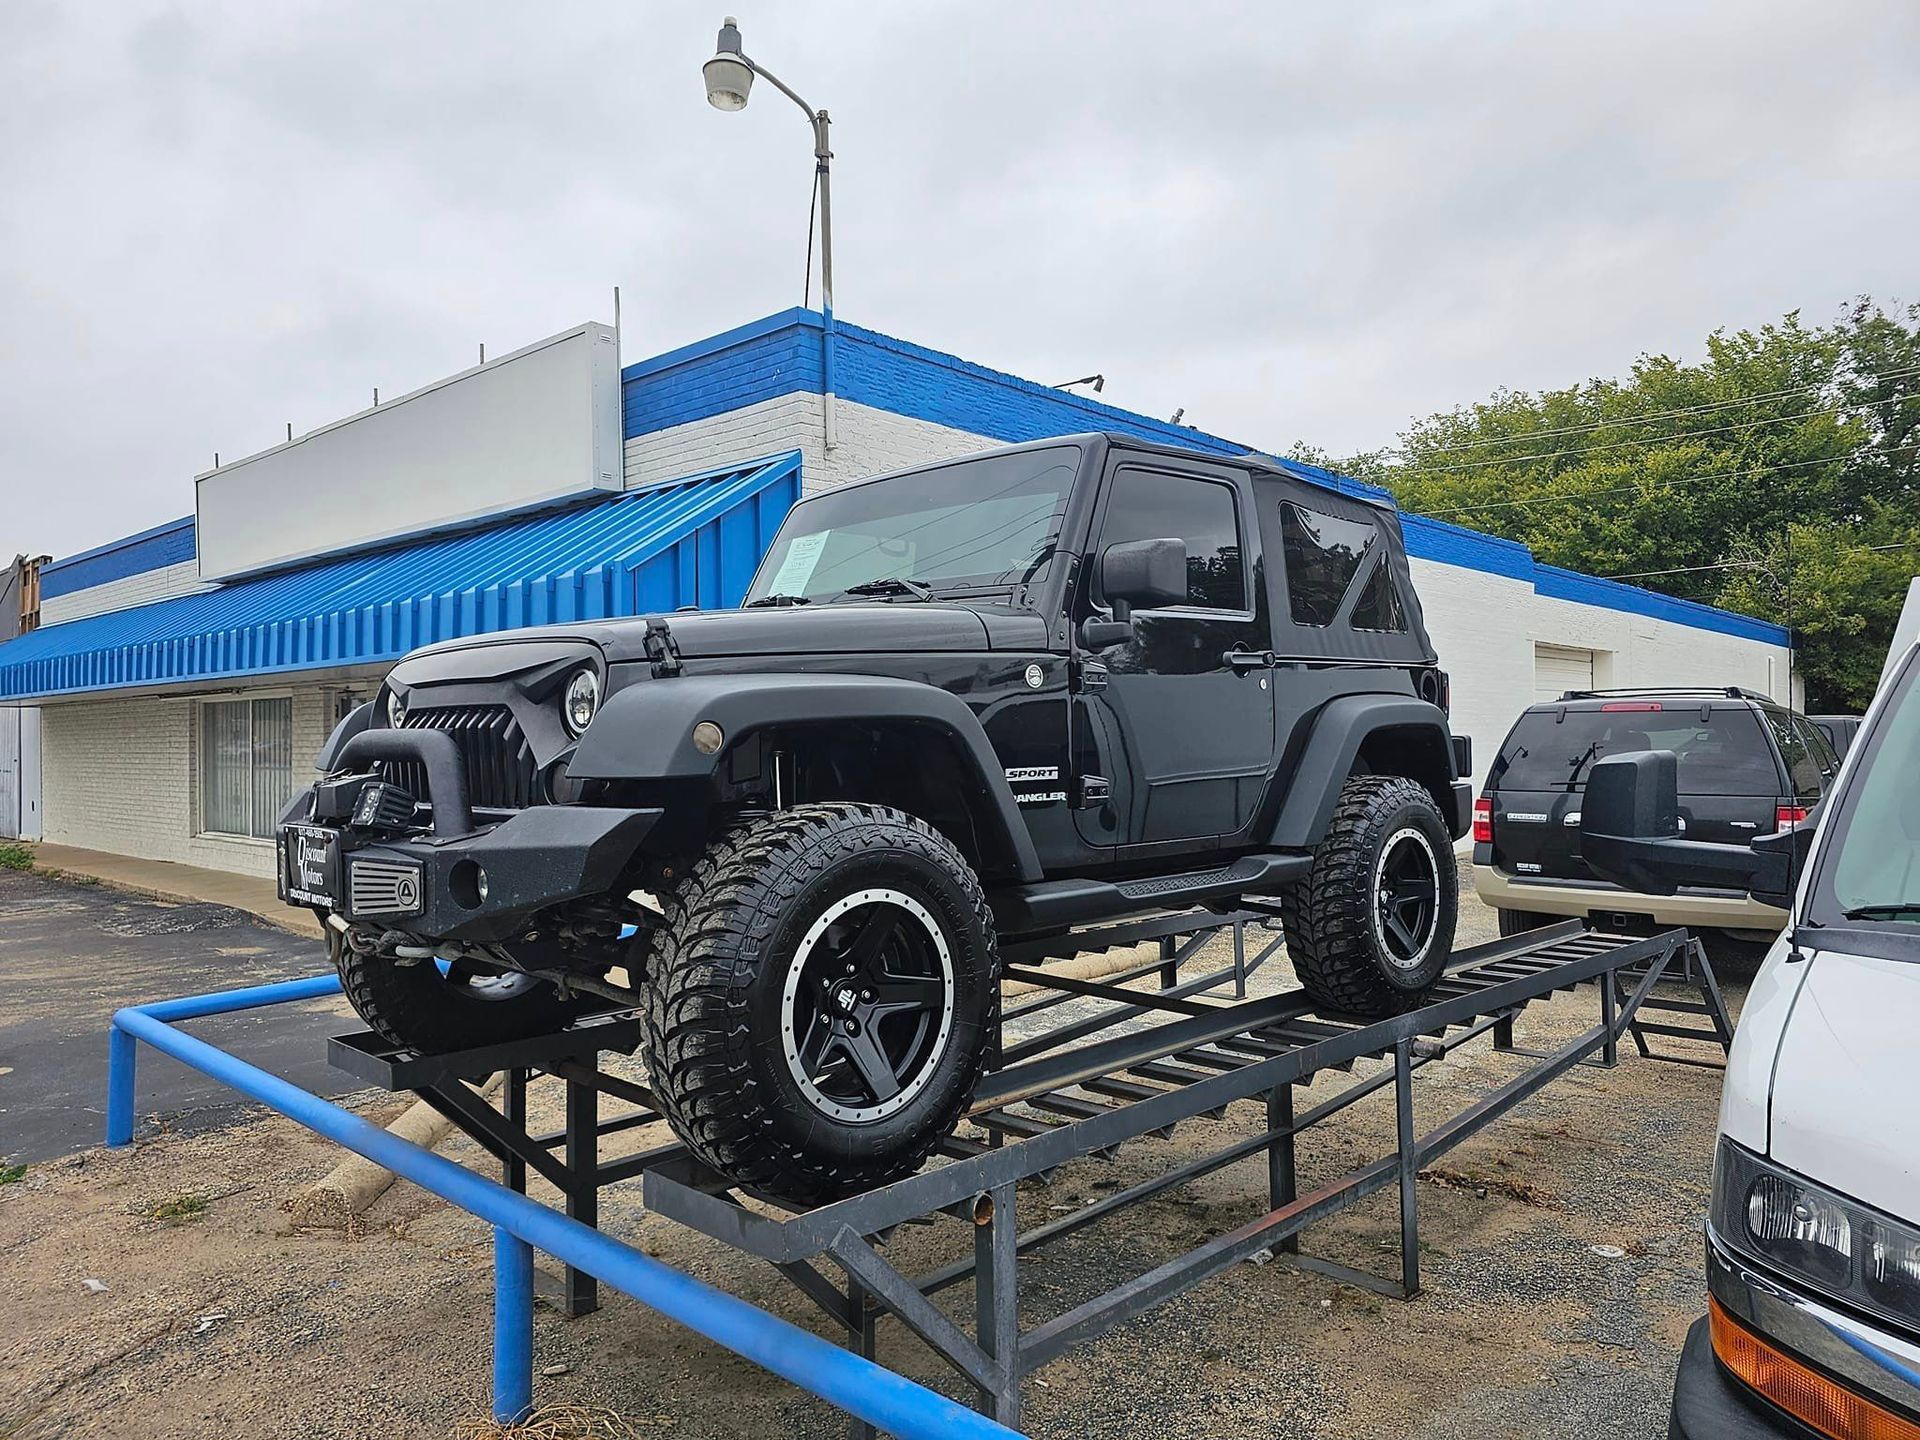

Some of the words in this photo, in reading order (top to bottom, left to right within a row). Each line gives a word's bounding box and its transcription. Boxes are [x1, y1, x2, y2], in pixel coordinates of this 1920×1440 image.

[1005, 768, 1058, 780] SPORT
[1013, 792, 1067, 803] ANGLER
[298, 836, 327, 866] Discount
[300, 860, 324, 891] Motors
[290, 888, 311, 902] DISCOUNT
[311, 892, 333, 907] MOTORS
